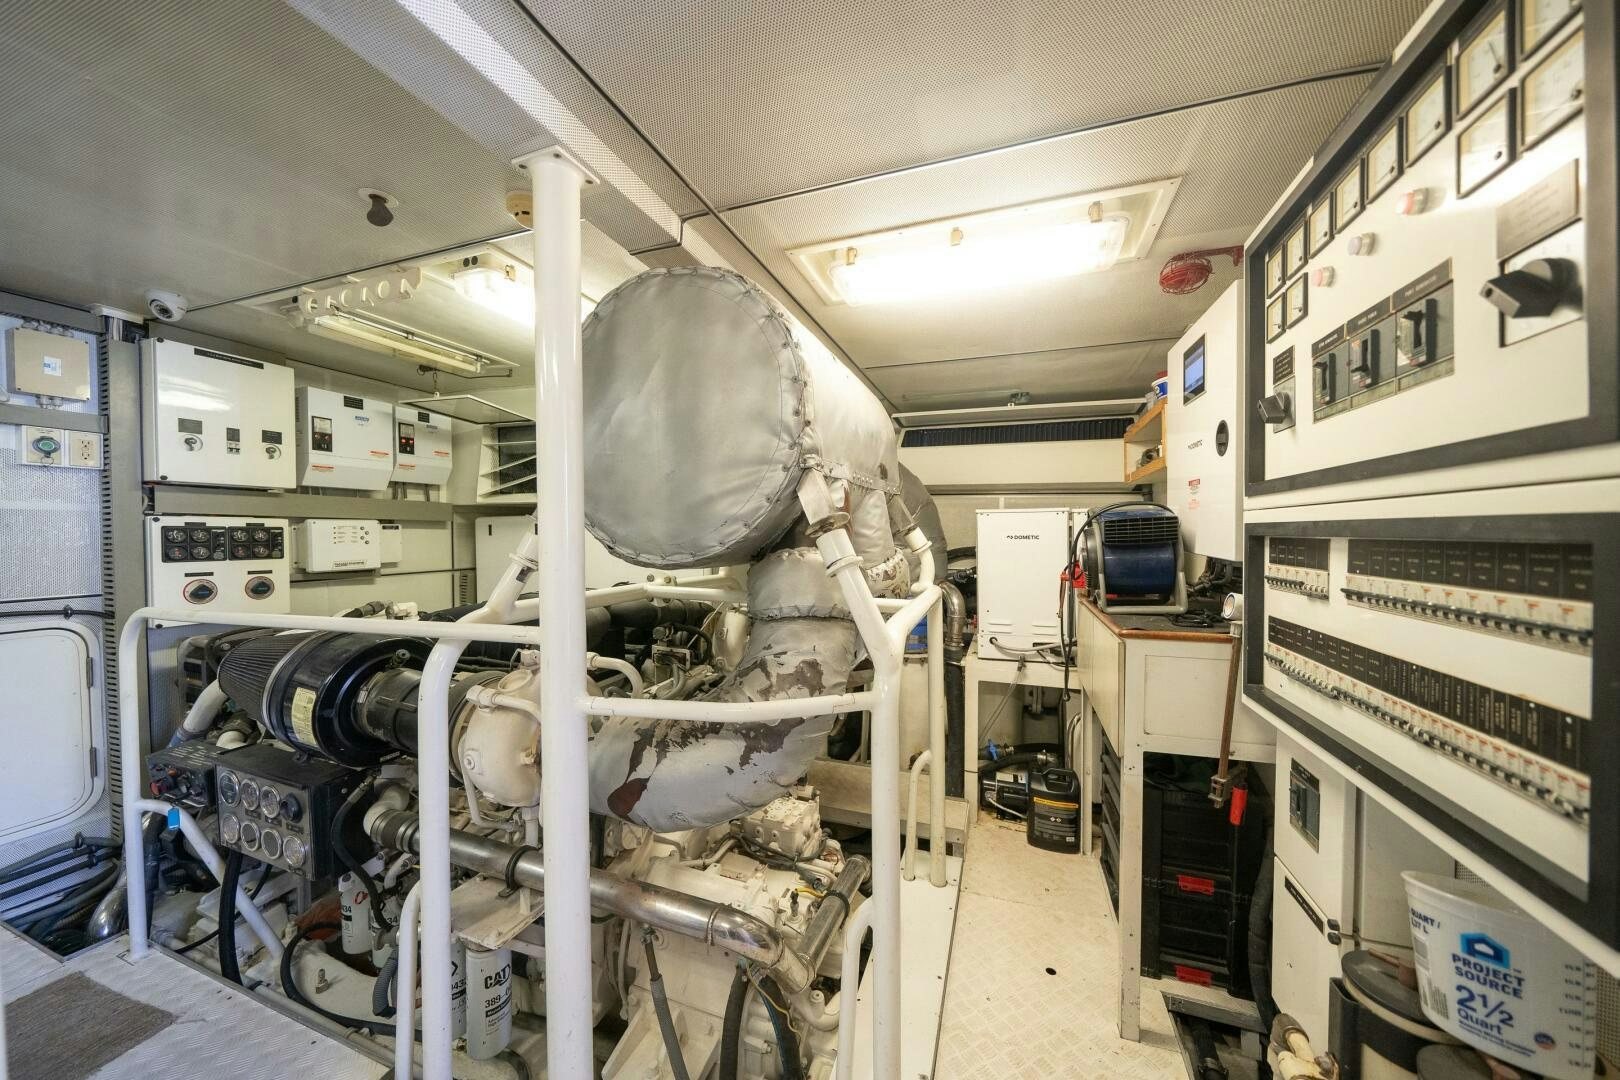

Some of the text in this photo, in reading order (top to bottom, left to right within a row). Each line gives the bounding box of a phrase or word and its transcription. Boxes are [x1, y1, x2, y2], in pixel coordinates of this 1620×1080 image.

[484, 964, 510, 989] CAT
[1452, 953, 1526, 988] PROJECT
[1454, 965, 1523, 1000] SOURCE
[1457, 1007, 1503, 1036] Quart
